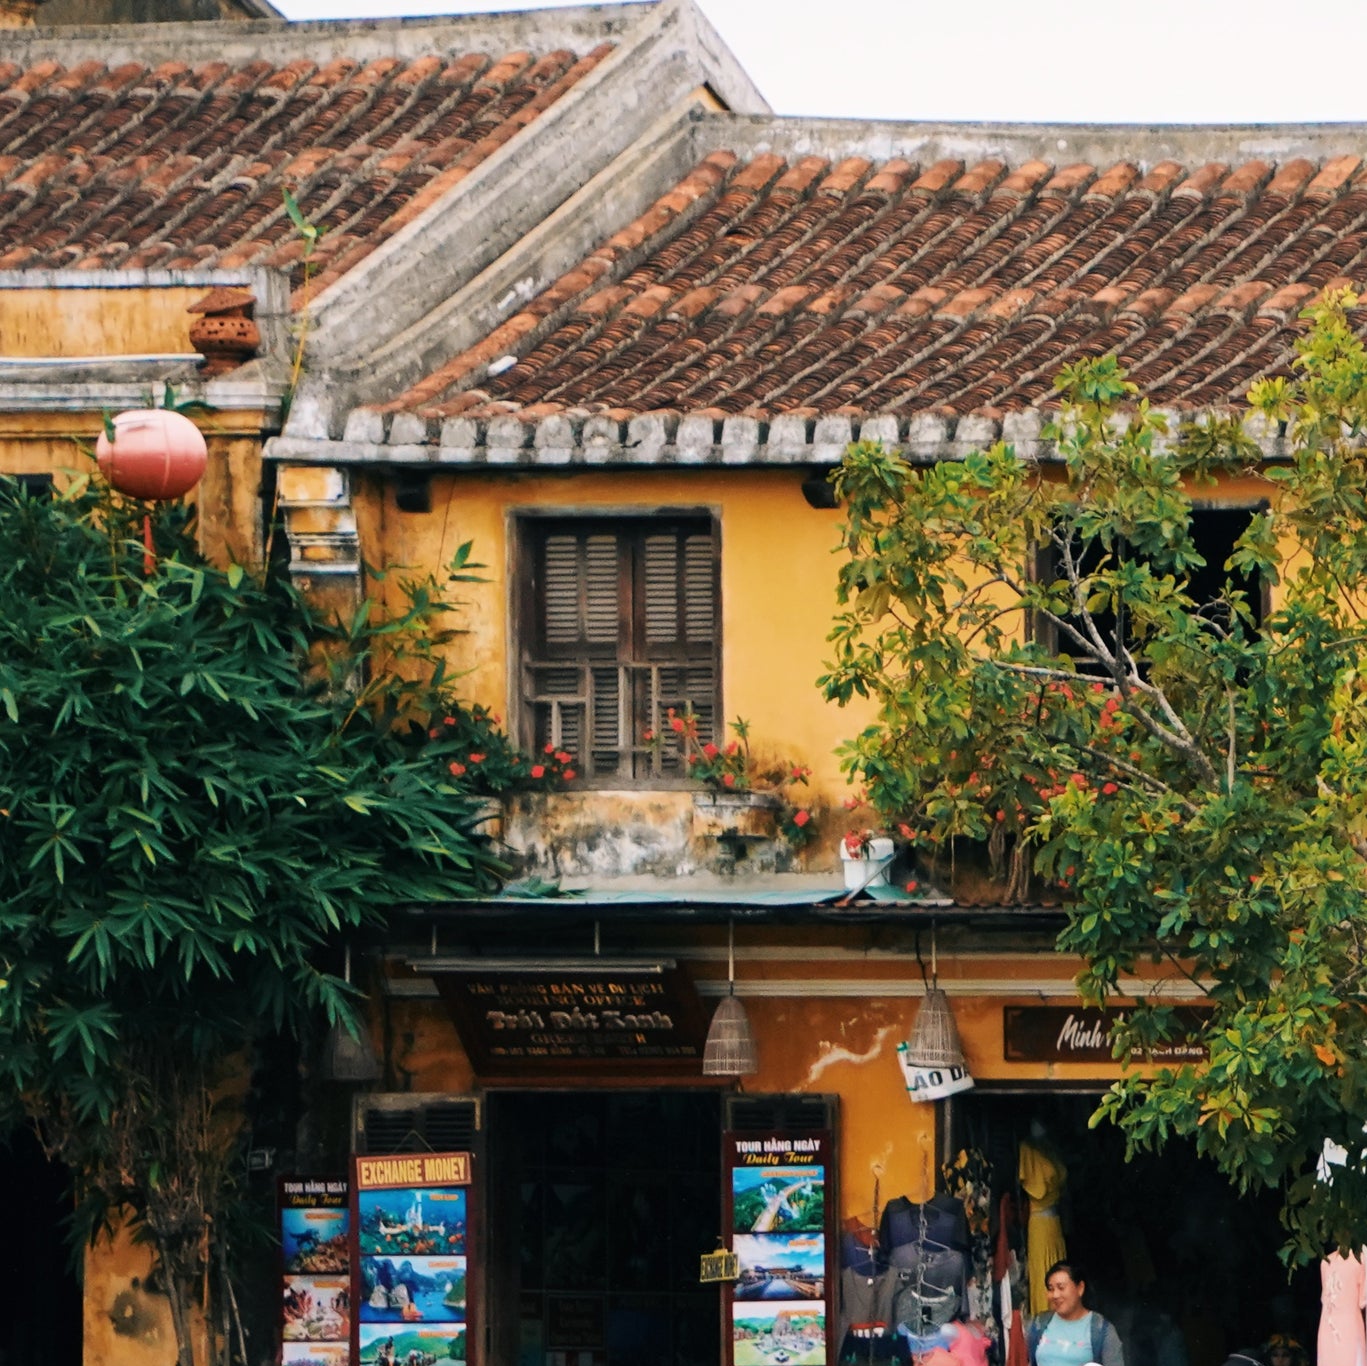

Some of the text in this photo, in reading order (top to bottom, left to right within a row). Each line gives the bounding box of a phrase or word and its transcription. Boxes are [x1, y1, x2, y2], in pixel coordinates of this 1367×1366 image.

[1057, 1014, 1102, 1051] Minh
[1130, 1047, 1143, 1055] 02
[735, 1141, 762, 1153] TOUR
[793, 1138, 821, 1152] NGÀY
[743, 1152, 814, 1165] Daily Tour
[360, 1156, 466, 1186] EXCHANGE MONEY
[284, 1182, 303, 1193] TOUR
